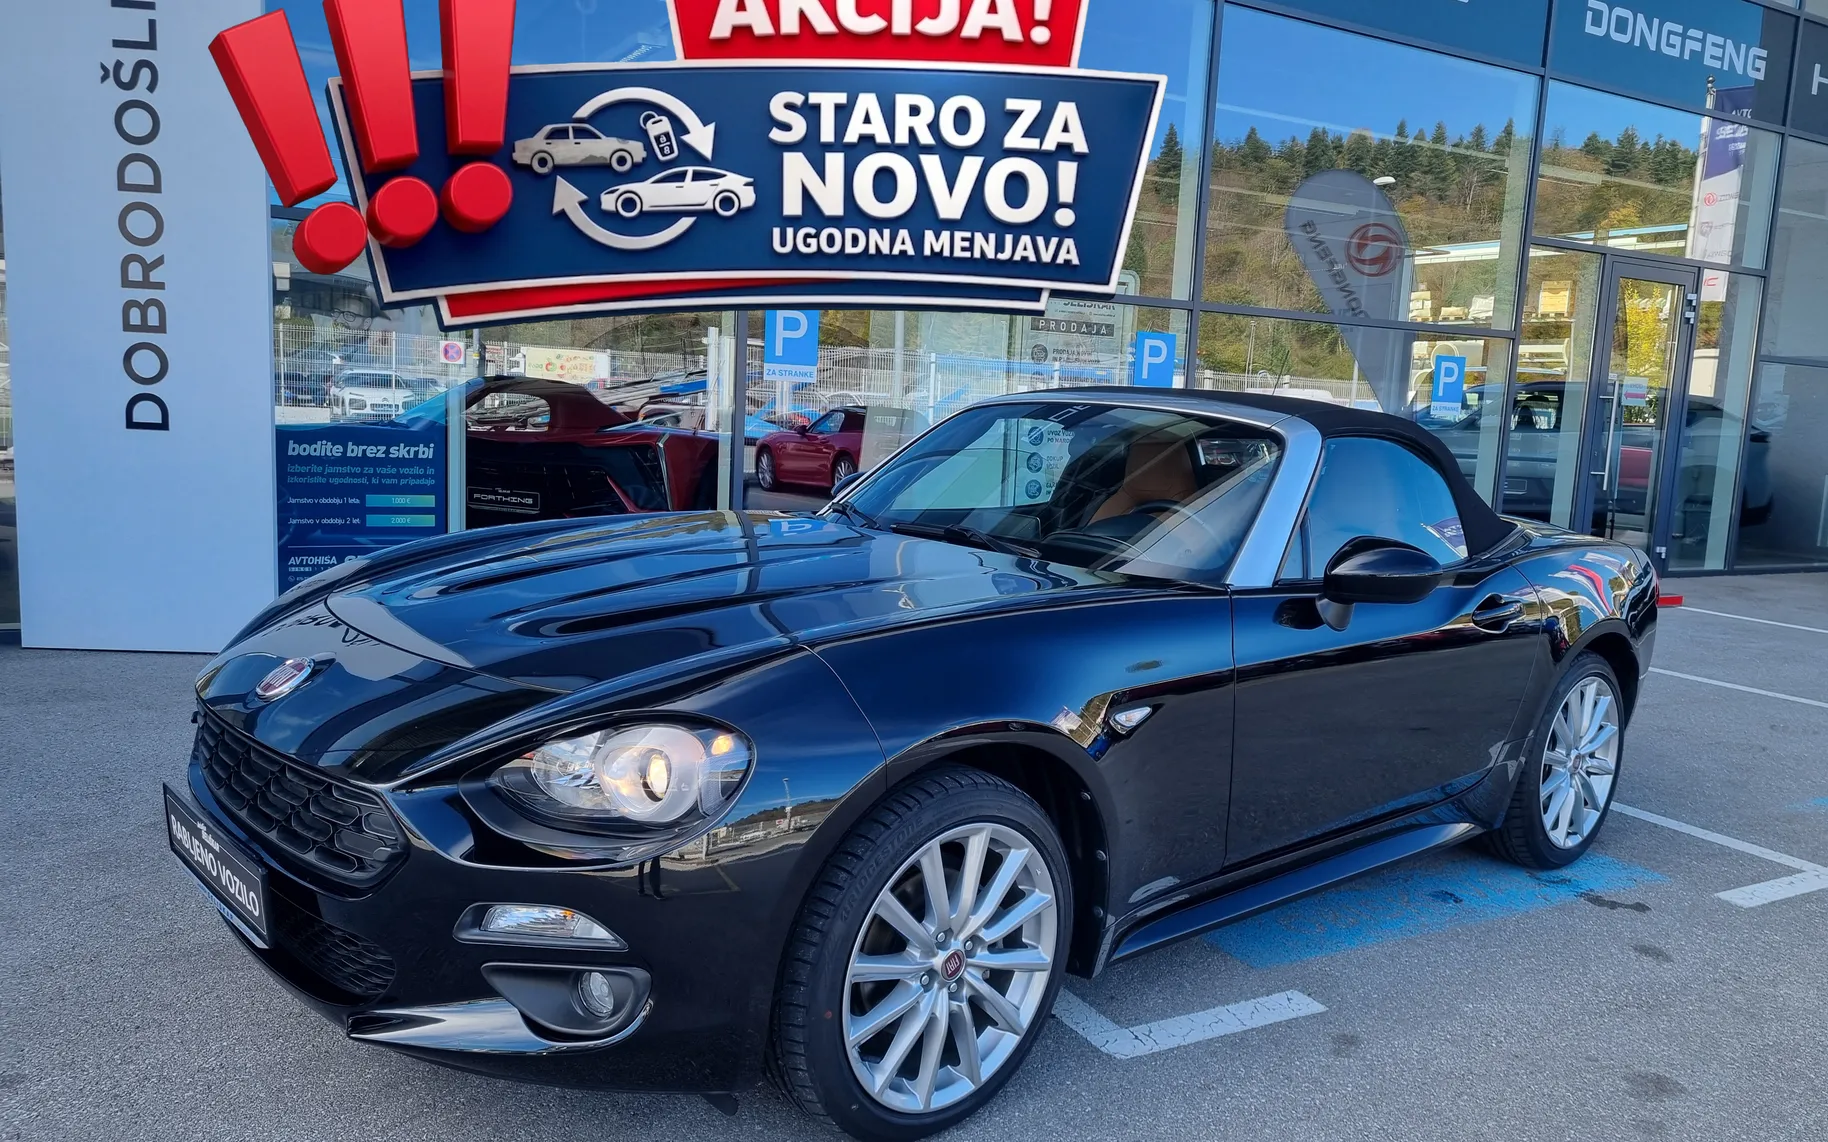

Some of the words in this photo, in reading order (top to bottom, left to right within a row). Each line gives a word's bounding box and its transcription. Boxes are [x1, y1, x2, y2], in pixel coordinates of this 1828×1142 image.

[1584, 0, 1768, 81] DONGFENG
[100, 0, 170, 431] DOBRODOŠLI
[775, 310, 808, 357] P
[1039, 319, 1107, 335] PRODAJA
[1141, 338, 1168, 379] P
[766, 368, 777, 376] ZA
[778, 369, 814, 378] STRANKE
[1438, 361, 1459, 397] P
[287, 440, 343, 456] bodite
[346, 442, 387, 457] brez
[389, 443, 434, 459] skrbi
[287, 464, 323, 473] izberite
[324, 464, 361, 474] jamstvo
[376, 465, 397, 474] vaše
[399, 466, 424, 475] vozilo
[426, 466, 435, 475] in
[287, 476, 327, 484] izkoristite
[329, 476, 369, 485] ugodnosti,
[371, 476, 379, 484] ki
[400, 477, 435, 486] pripadajo
[319, 497, 343, 505] obdobju
[321, 517, 345, 525] obdobju
[288, 555, 337, 566] AVTOHIŠA
[171, 814, 217, 877] RABLJENO
[217, 860, 260, 917] VOZILO
